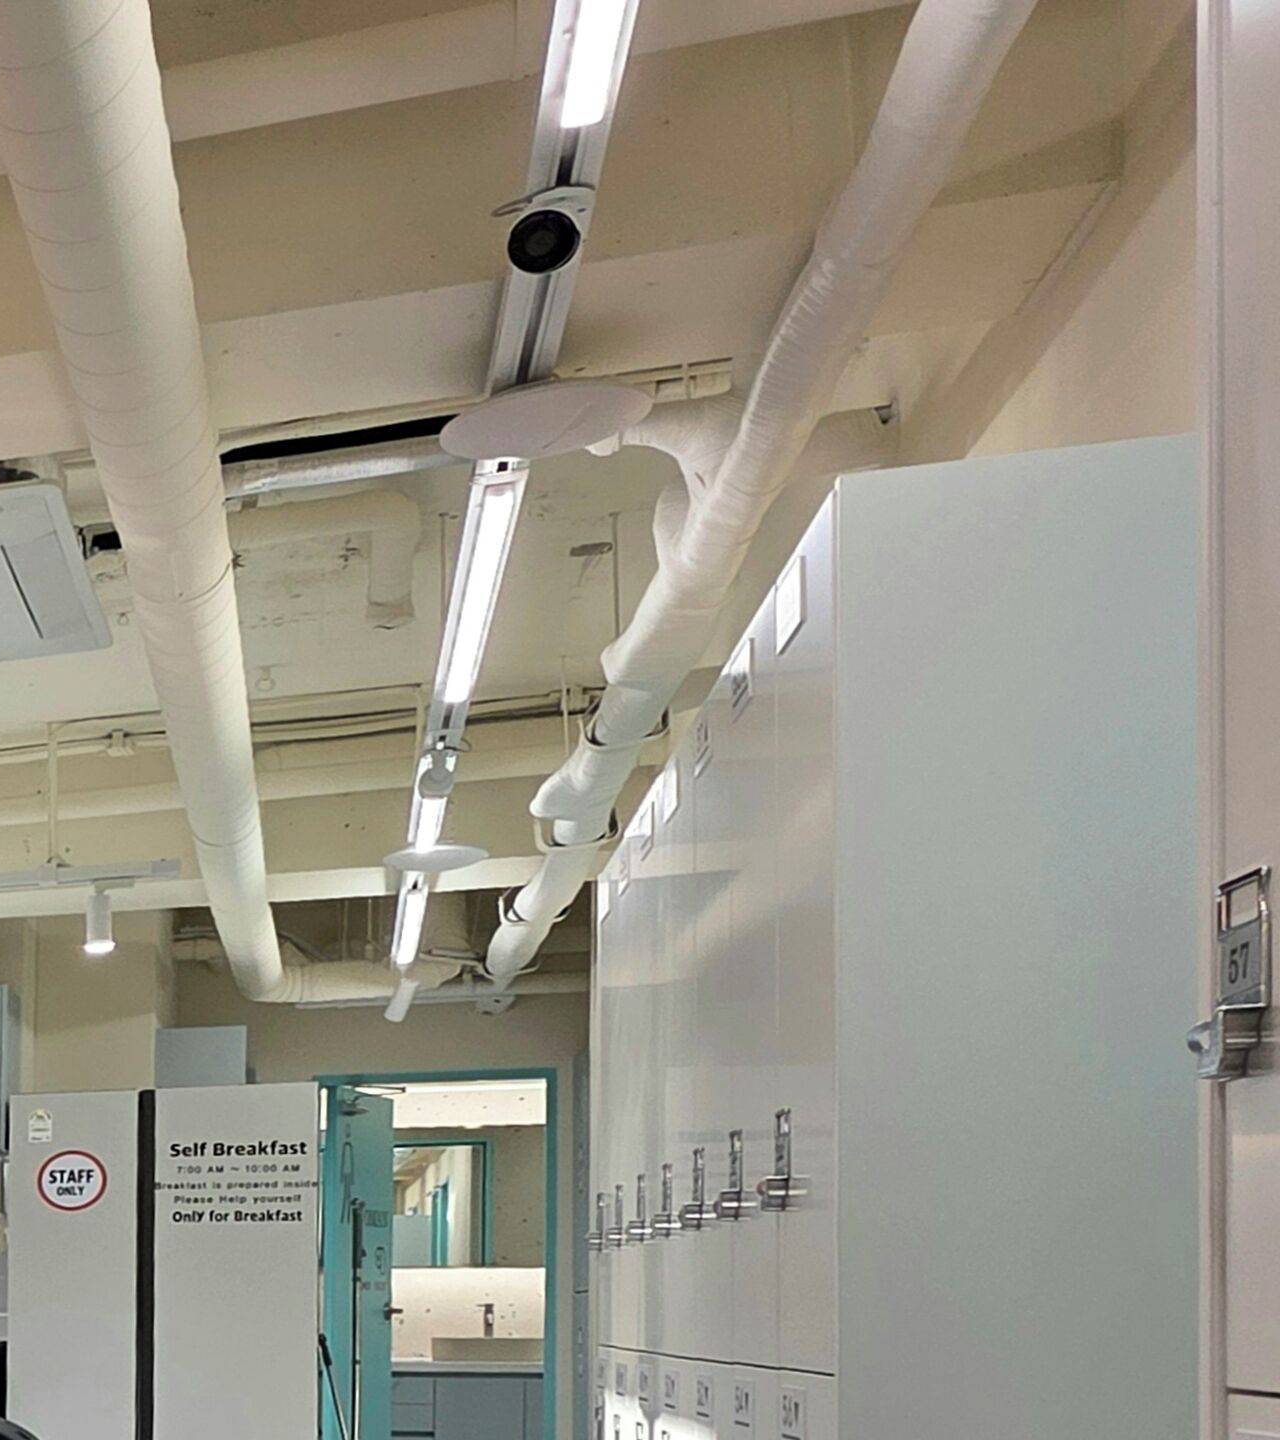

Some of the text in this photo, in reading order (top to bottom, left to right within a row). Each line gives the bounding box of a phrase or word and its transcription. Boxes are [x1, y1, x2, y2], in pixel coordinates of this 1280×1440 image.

[1228, 942, 1250, 984] 57
[169, 1140, 308, 1157] Self Breakfast
[283, 1164, 300, 1172] AM
[48, 1169, 95, 1184] STAFF
[56, 1185, 85, 1196] ONLY
[154, 1181, 207, 1190] Breakfast
[227, 1181, 278, 1191] prepared
[174, 1193, 302, 1204] Please Help yourself
[209, 1210, 230, 1221] for
[234, 1209, 302, 1222] Breakfast
